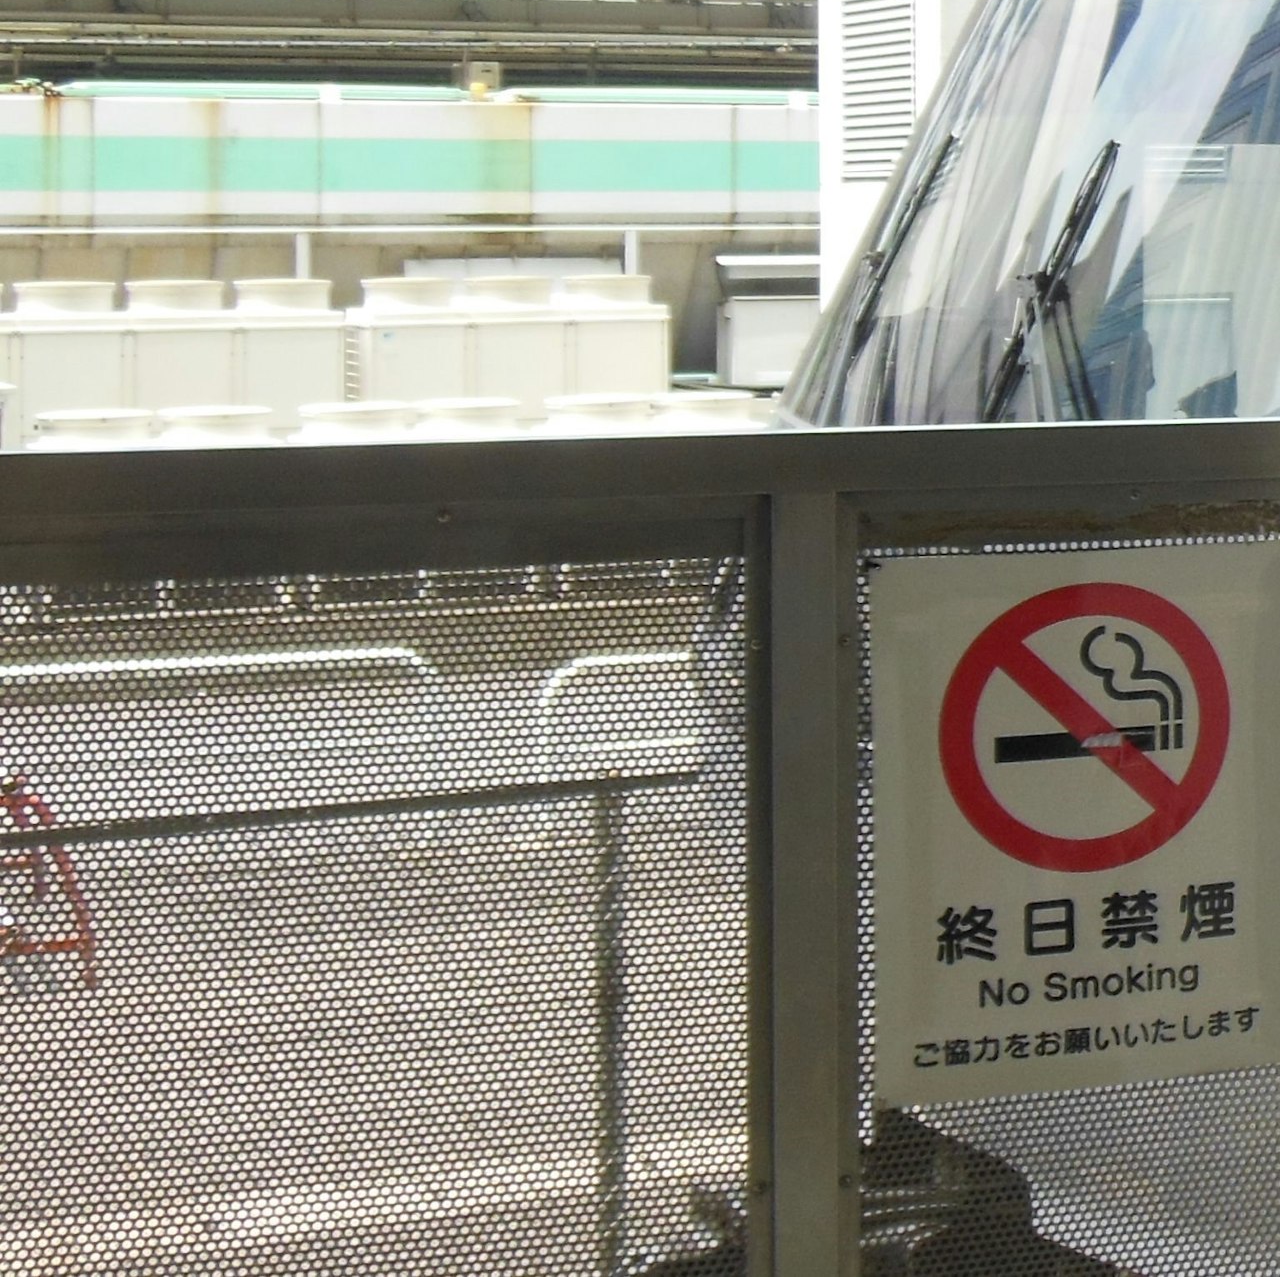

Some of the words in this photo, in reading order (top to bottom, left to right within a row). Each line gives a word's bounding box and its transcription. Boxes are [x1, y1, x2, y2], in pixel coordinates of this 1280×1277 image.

[936, 881, 1236, 965] 終日禁煙
[978, 977, 1030, 1008] No
[1043, 962, 1199, 1003] Smoking
[912, 1006, 1260, 1068] ご協力をお願いいたします
